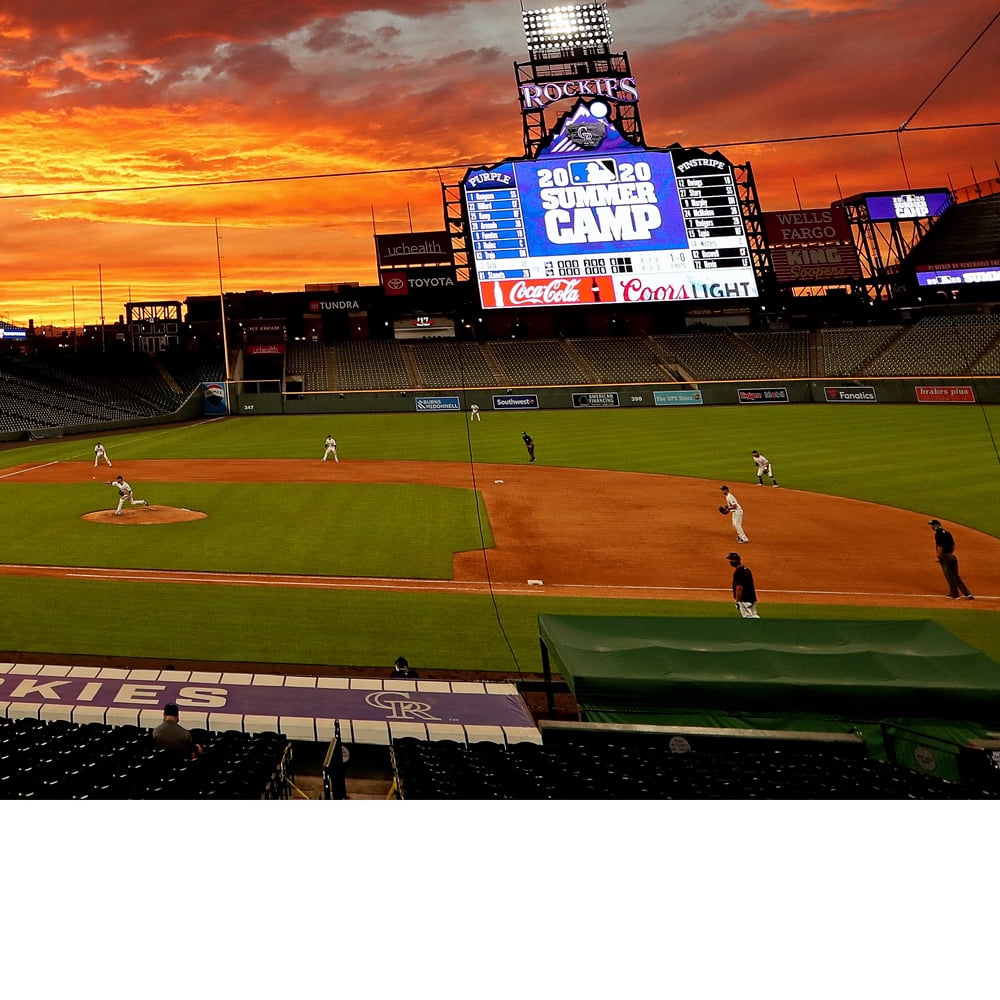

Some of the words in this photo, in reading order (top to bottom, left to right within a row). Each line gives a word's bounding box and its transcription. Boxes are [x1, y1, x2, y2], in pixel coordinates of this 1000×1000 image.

[520, 77, 639, 109] ROCKIES
[677, 158, 726, 173] PINSTRIPE
[468, 172, 512, 188] PURPLE
[536, 168, 569, 188] 20
[618, 162, 652, 182] 20
[540, 181, 658, 210] SUMMER
[544, 203, 662, 245] CAMP
[776, 212, 832, 225] WELLS
[781, 226, 836, 240] FARGO
[388, 240, 442, 257] uchealth
[786, 248, 842, 266] KING
[790, 264, 845, 281] Soopers
[408, 277, 454, 288] TOYOTA
[620, 278, 690, 302] Coors
[692, 282, 750, 300] LIGHT
[509, 278, 581, 304] Coca-Cola
[320, 300, 360, 310] TUNDRA
[840, 390, 874, 400] Fanatics
[920, 388, 948, 396] brakes
[951, 388, 969, 397] plus
[496, 398, 530, 406] Southwest
